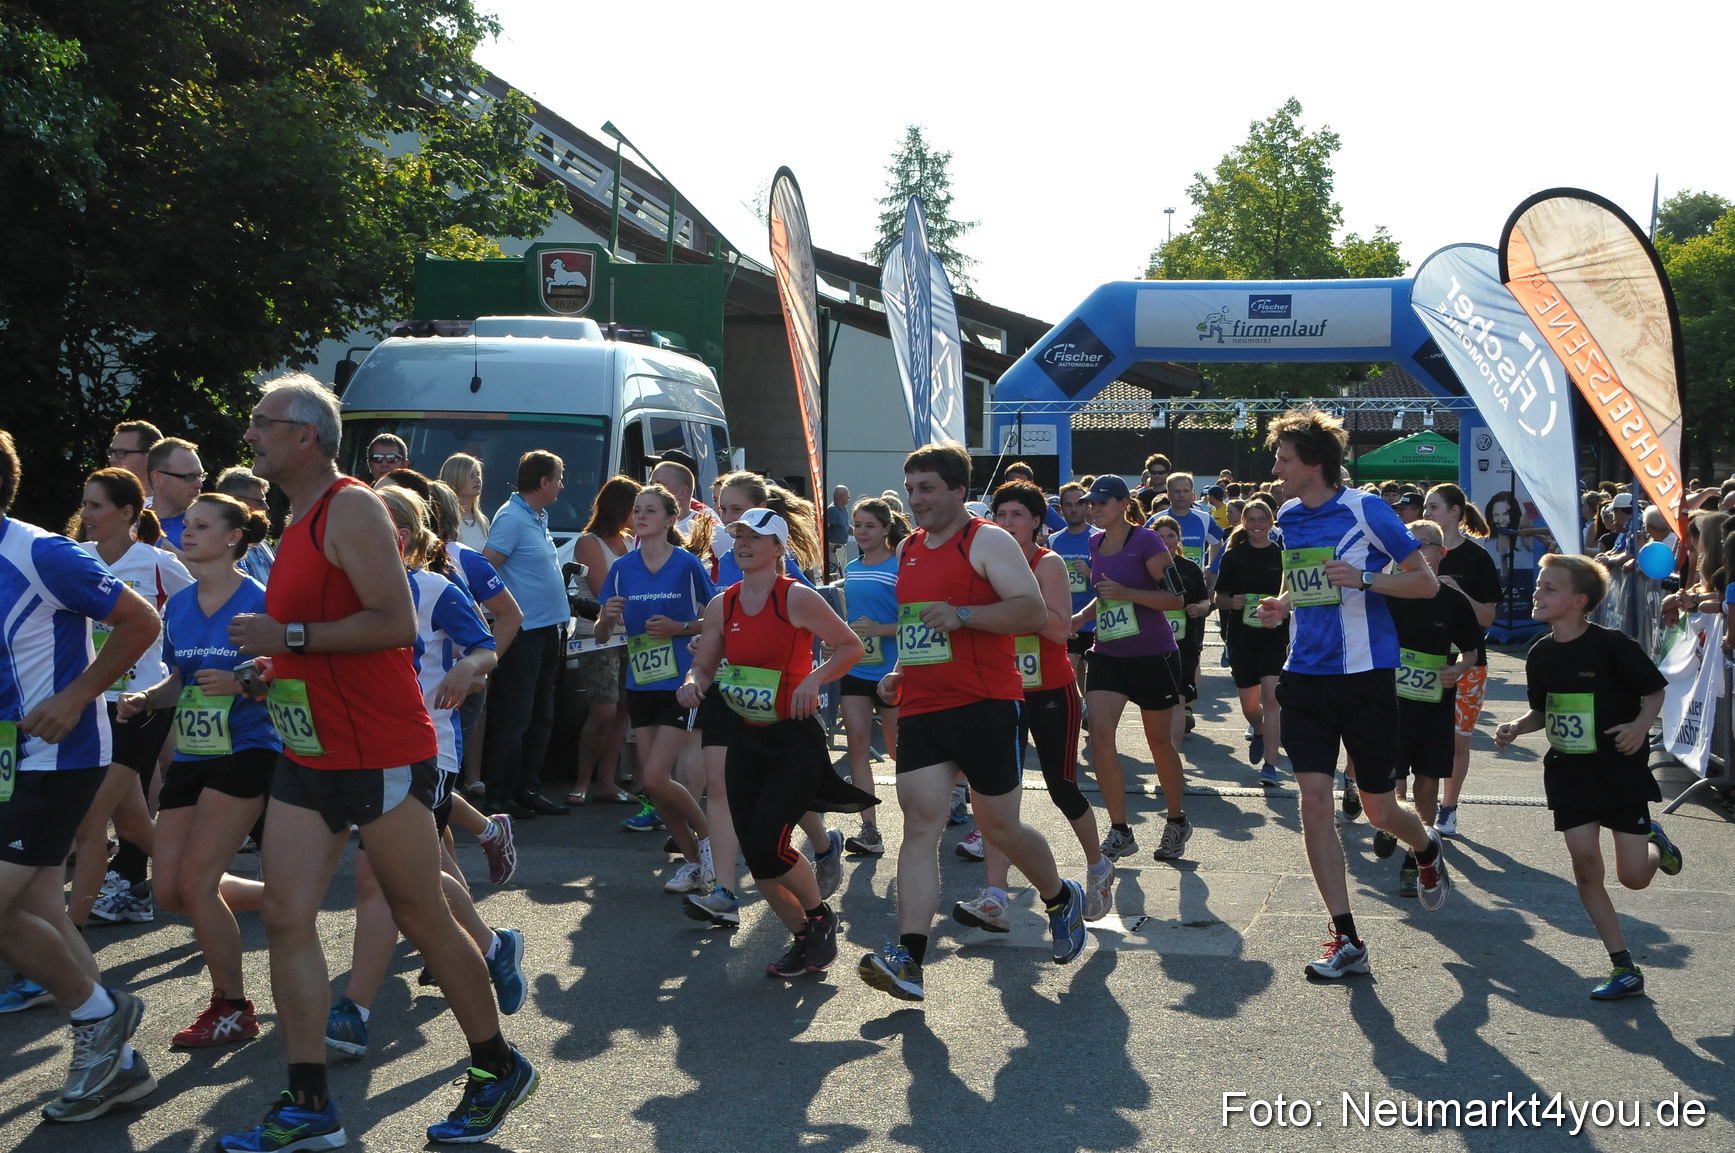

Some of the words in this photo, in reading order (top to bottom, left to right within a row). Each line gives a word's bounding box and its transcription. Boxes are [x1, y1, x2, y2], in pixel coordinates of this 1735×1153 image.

[555, 299, 578, 310] 1628
[1257, 302, 1289, 310] Fischer
[1232, 319, 1328, 337] firmenlauf
[1054, 350, 1104, 363] Fischer
[628, 591, 681, 601] energiegeladen
[1100, 607, 1128, 630] 504
[897, 624, 947, 650] 1324
[631, 646, 671, 673] 1257
[1396, 666, 1437, 691] 252
[721, 685, 772, 712] 1323
[175, 709, 224, 738] 1251
[269, 699, 313, 738] 1313
[1548, 713, 1584, 739] 253
